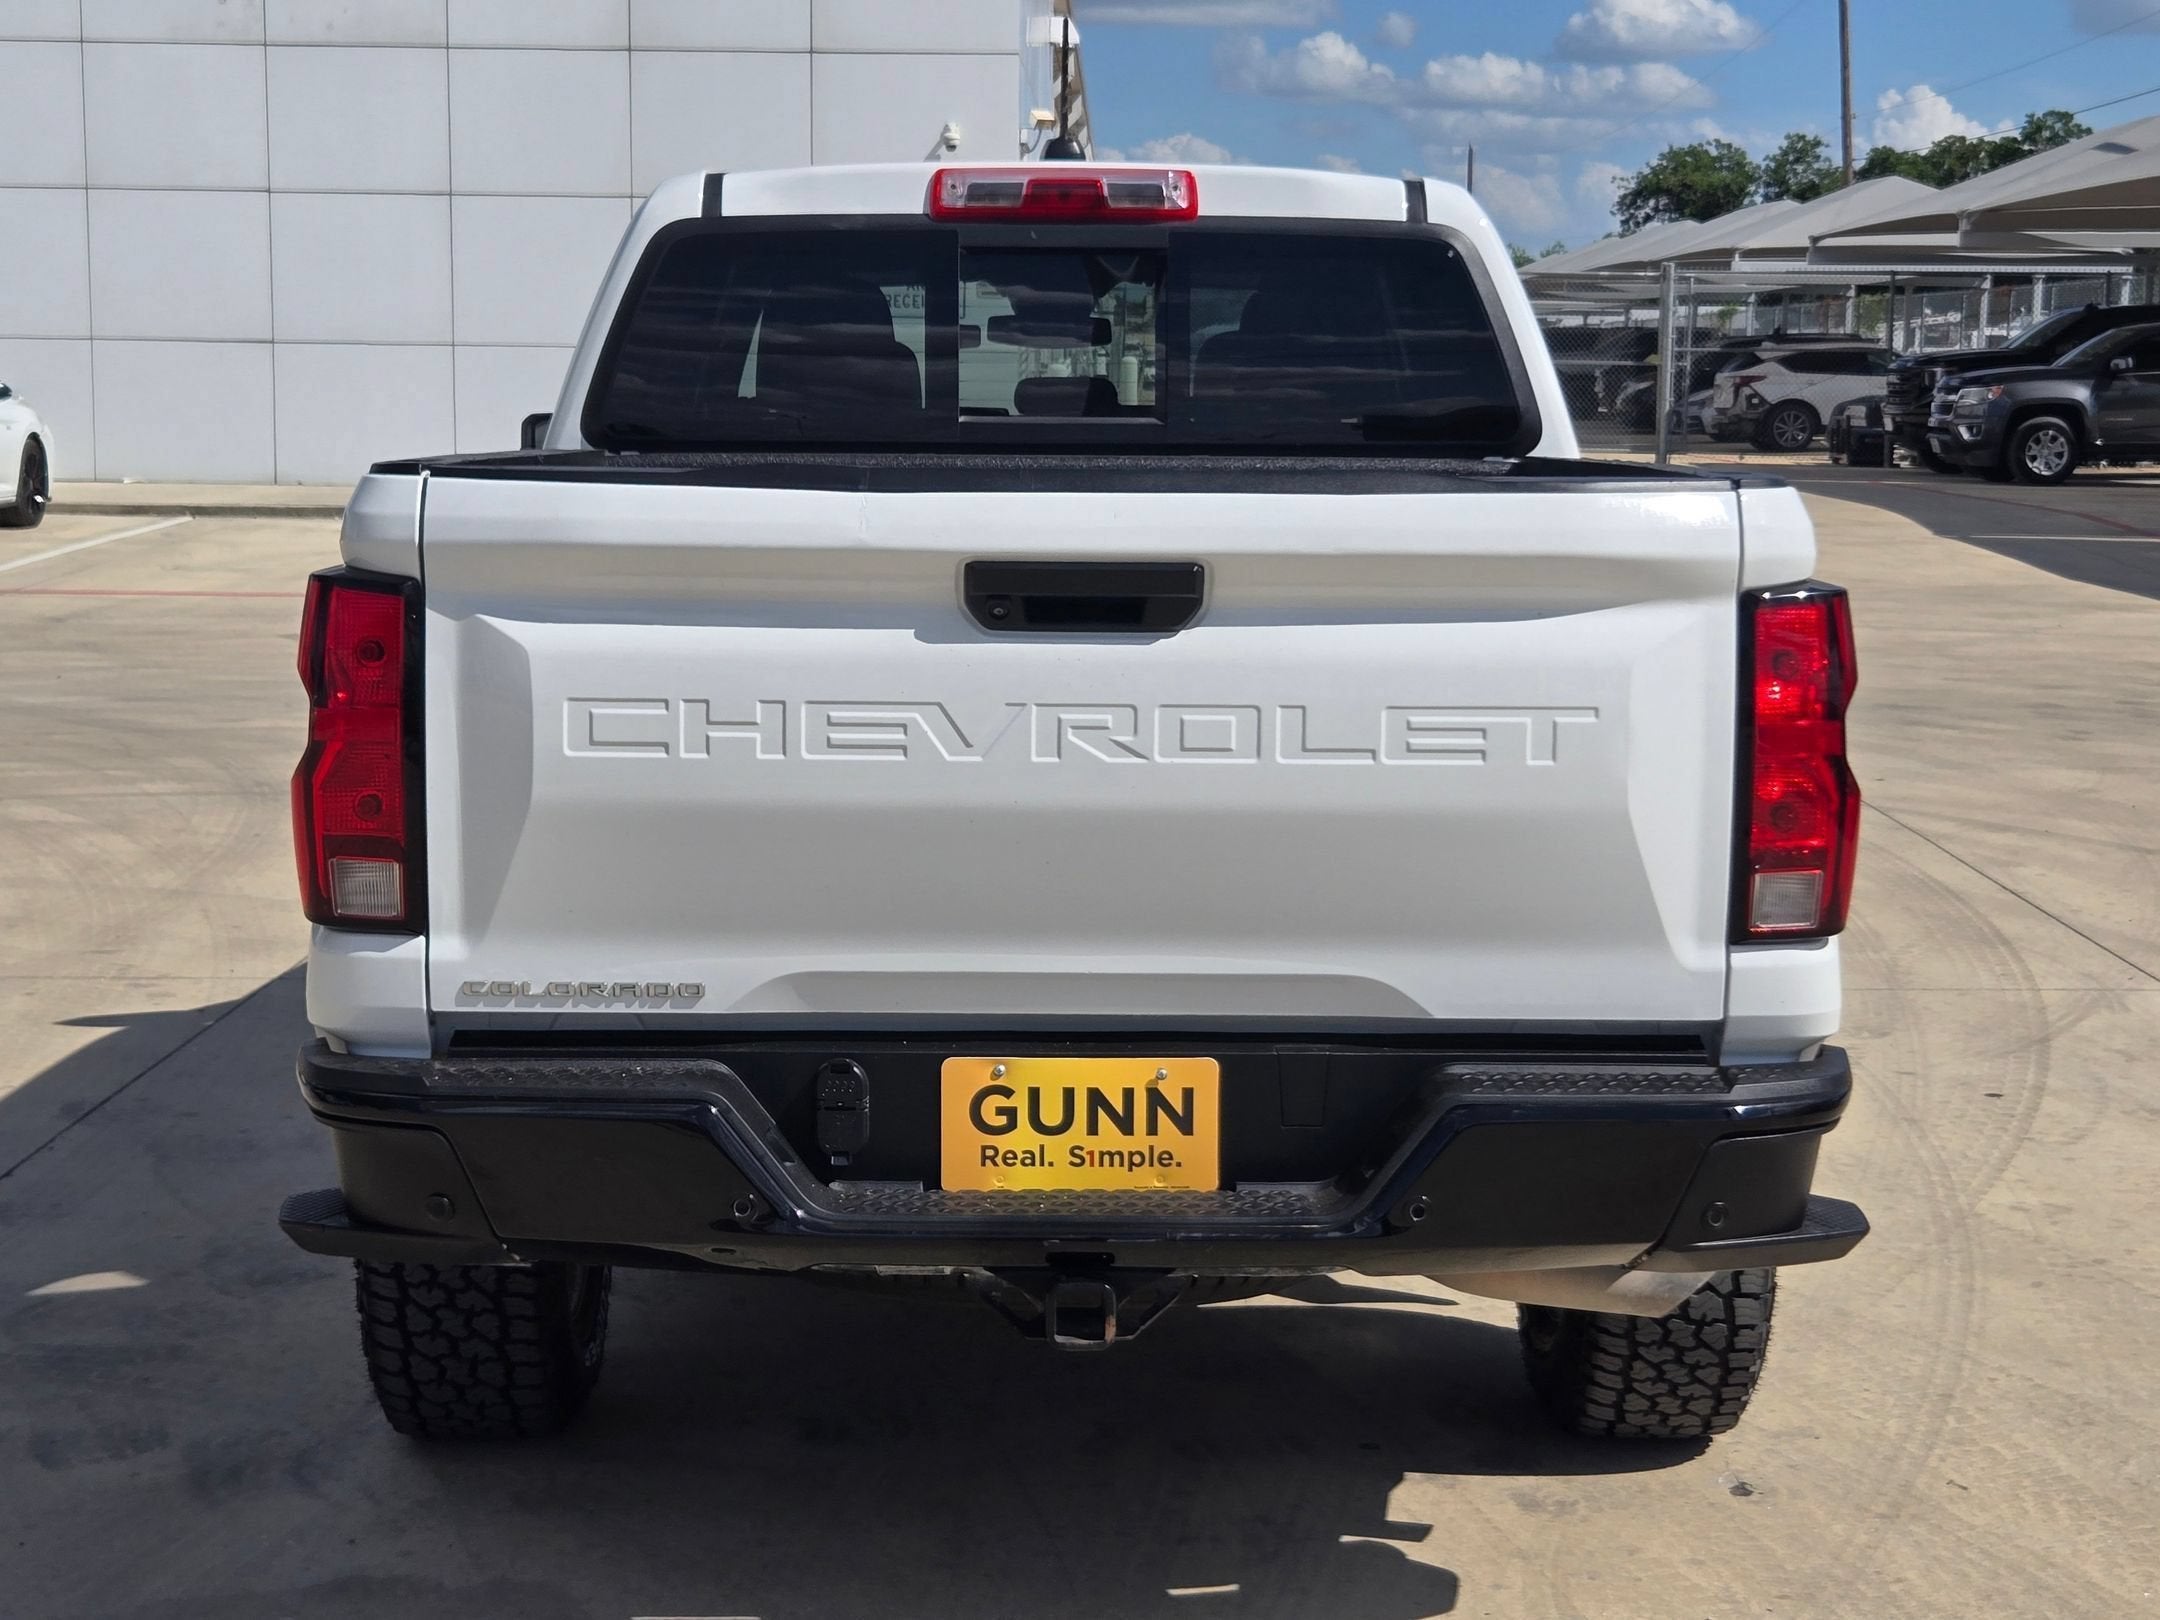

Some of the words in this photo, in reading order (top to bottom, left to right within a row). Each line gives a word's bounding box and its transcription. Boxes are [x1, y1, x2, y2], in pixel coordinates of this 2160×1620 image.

[563, 698, 1599, 765] CHEVROLET
[462, 980, 706, 998] COLORADO
[968, 1084, 1194, 1137] GUNN
[979, 1144, 1054, 1168] Real.
